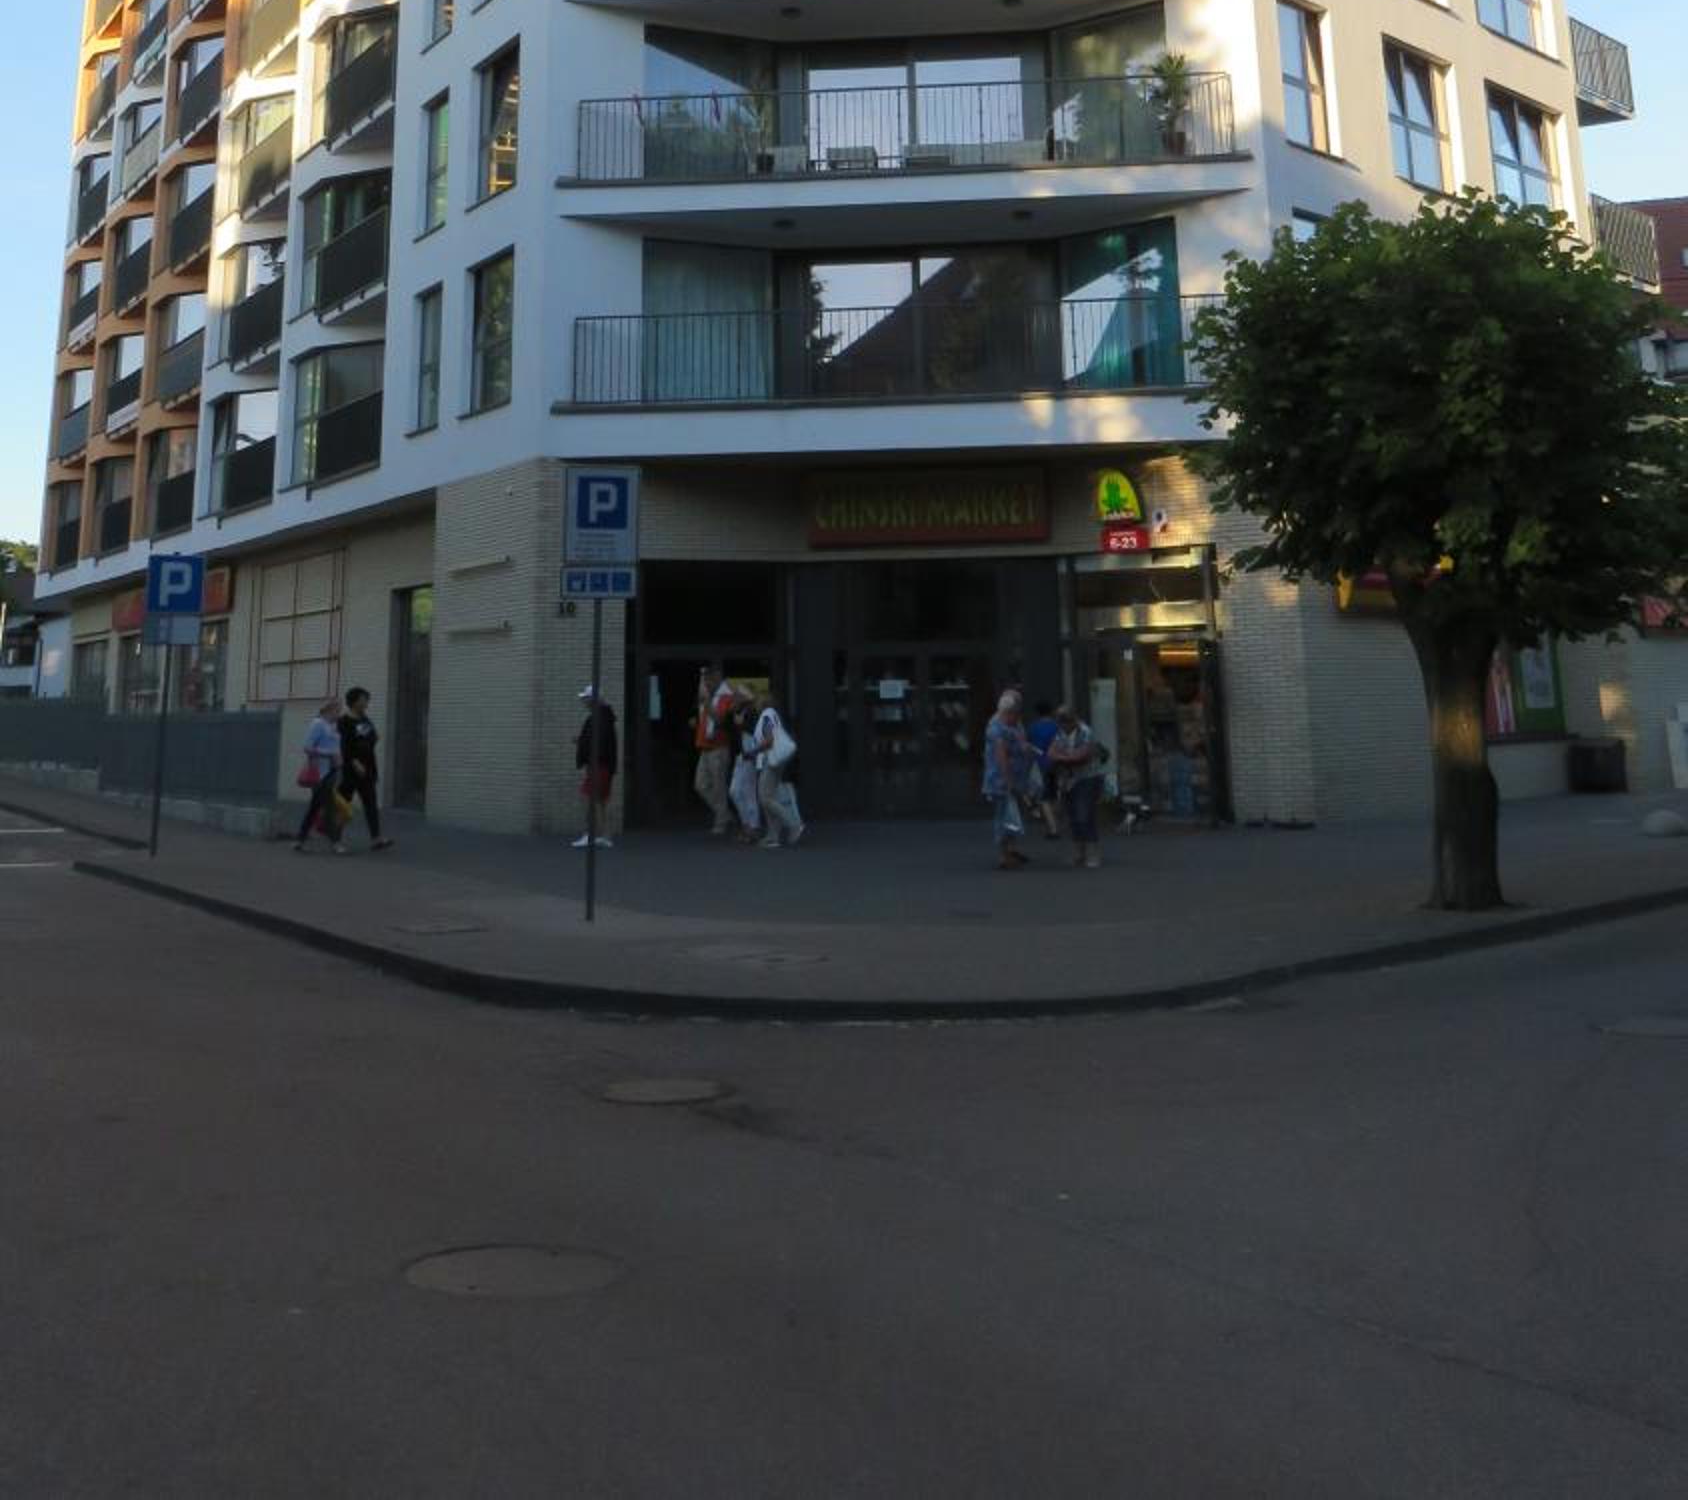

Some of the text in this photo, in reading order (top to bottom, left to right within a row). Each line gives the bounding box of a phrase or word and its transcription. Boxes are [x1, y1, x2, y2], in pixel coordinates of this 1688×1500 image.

[588, 482, 618, 523] P
[925, 483, 1038, 526] MARKET
[160, 562, 193, 606] P
